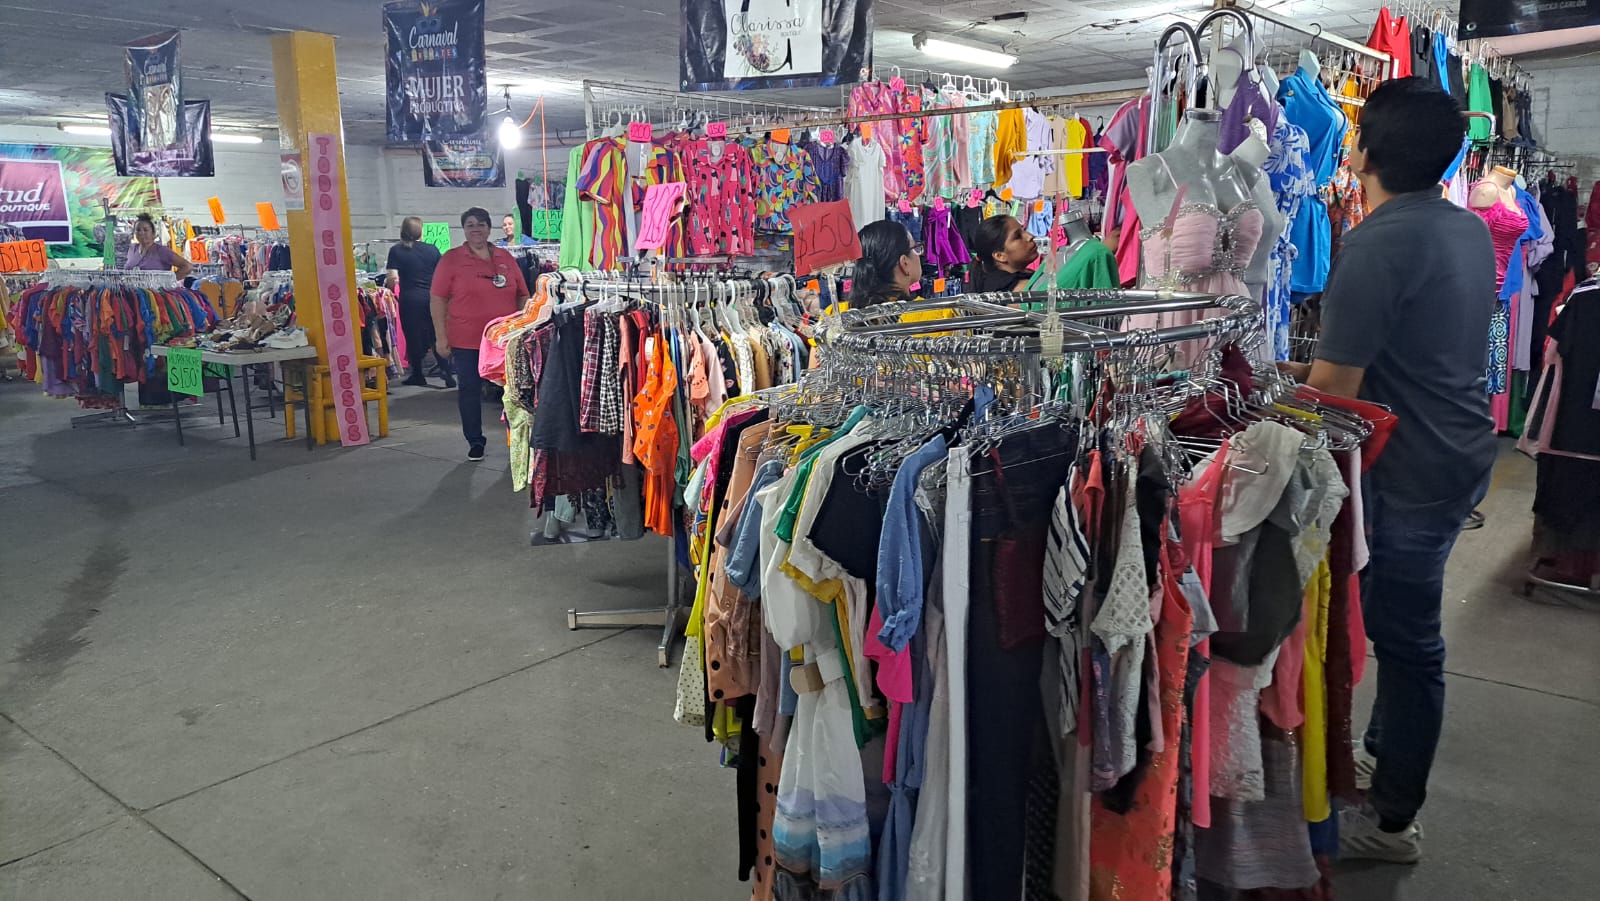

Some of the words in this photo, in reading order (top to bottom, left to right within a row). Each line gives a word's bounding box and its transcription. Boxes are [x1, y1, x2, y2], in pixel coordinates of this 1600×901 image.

[409, 20, 459, 49] Carnaval
[731, 13, 805, 35] Clarissa
[406, 75, 465, 101] MUJER
[409, 99, 465, 114] PRODUCTIVA
[316, 137, 333, 211] TODO
[0, 203, 51, 213] OUTIQUE
[321, 229, 338, 266] EN
[796, 212, 854, 265] $150
[169, 366, 199, 389] $150
[336, 354, 361, 442] PESOS
